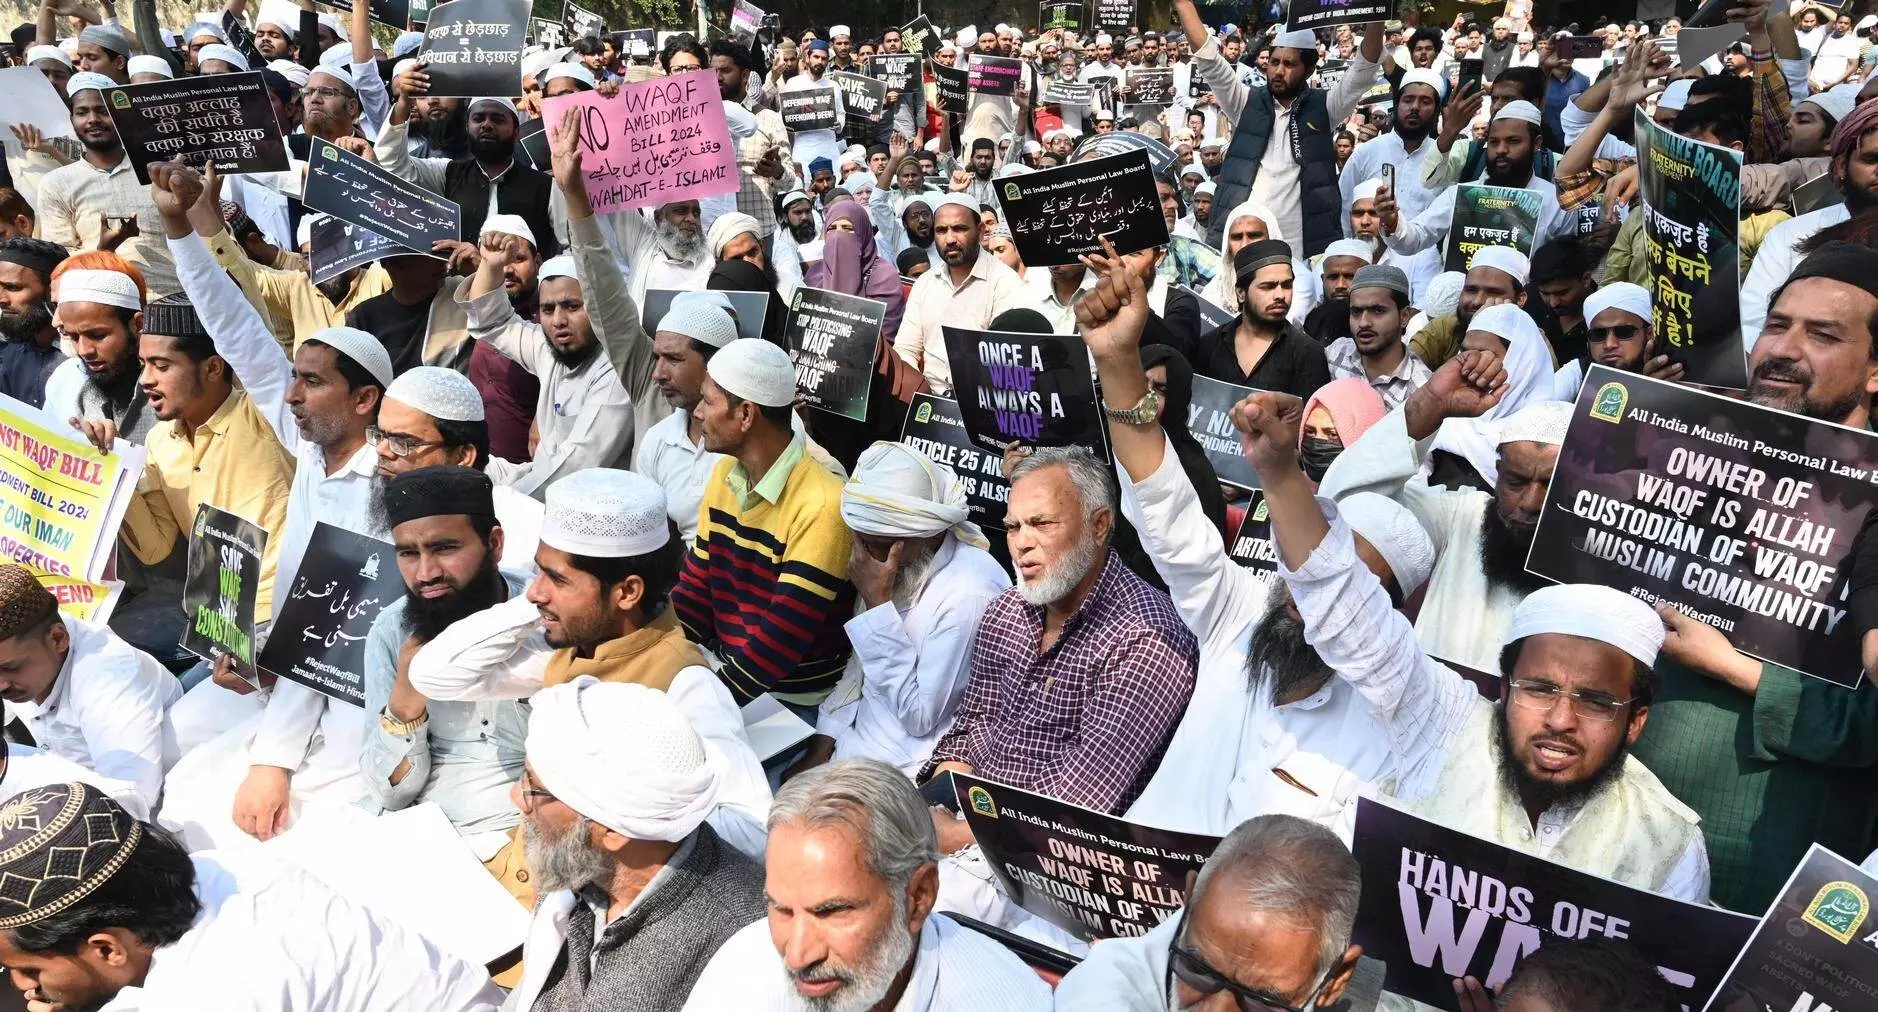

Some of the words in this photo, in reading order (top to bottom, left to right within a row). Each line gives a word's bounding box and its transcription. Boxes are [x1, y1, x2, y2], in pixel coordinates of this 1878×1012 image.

[886, 63, 907, 74] WAQF
[143, 93, 162, 102] India
[164, 91, 190, 100] Muslim
[191, 86, 222, 98] Personal
[239, 83, 259, 91] Board
[626, 80, 697, 113] WAQF
[838, 78, 866, 94] SAVE
[887, 79, 907, 89] WAQF
[849, 93, 878, 113] WAQF
[623, 102, 709, 136] AMENDMENT
[187, 131, 205, 146] के
[631, 133, 666, 152] BILL
[670, 123, 703, 142] 2024
[1650, 148, 1695, 178] FRATERNITY
[1656, 164, 1683, 181] MOVEMENT
[368, 171, 392, 186] Muslim
[1022, 187, 1033, 195] All
[1033, 183, 1050, 193] India
[1051, 181, 1076, 190] Muslim
[1077, 173, 1107, 185] Personal
[1109, 170, 1123, 178] Law
[1124, 164, 1145, 173] Board
[1059, 198, 1073, 211] تحفظ
[1078, 195, 1093, 207] کے
[1114, 207, 1124, 217] اور
[1478, 198, 1516, 207] FRATERNITY
[1032, 218, 1045, 230] تحفظ
[1050, 217, 1064, 227] کے
[1067, 213, 1085, 227] حقوق
[1464, 226, 1477, 237] हम
[1479, 228, 1509, 242] एकजुट
[1654, 210, 1693, 248] एकजुट
[1665, 242, 1712, 286] बेचने
[1658, 275, 1692, 319] लिए
[797, 314, 810, 327] STOP
[814, 305, 829, 313] Muslim
[829, 308, 849, 318] Personal
[850, 312, 861, 320] Law
[861, 315, 878, 324] Board
[801, 327, 836, 359] WAQF
[979, 341, 1022, 368] ONCE
[1031, 346, 1044, 371] A
[988, 364, 1036, 394] WAQF
[977, 385, 1042, 415] ALWAYS
[1051, 392, 1065, 418] A
[940, 416, 956, 426] India
[994, 408, 1044, 442] WAQF
[903, 435, 958, 466] ARTICLE
[958, 449, 980, 471] 25
[1627, 408, 1648, 423] All
[1650, 413, 1688, 433] India
[1691, 424, 1749, 451] Muslim
[1752, 440, 1826, 470] Personal
[1829, 460, 1868, 480] Law
[23, 433, 60, 472] WAQF
[59, 451, 103, 486] BILL
[1668, 447, 1766, 499] OWNER
[1771, 477, 1813, 509] OF
[30, 487, 54, 509] BILL
[3, 504, 32, 535] OUR
[34, 518, 74, 552] IMAN
[1637, 473, 1707, 520] WAQF
[1710, 496, 1741, 528] IS
[1744, 508, 1836, 556] ALLAH
[1573, 489, 1704, 555] CUSTODIAN
[1710, 534, 1747, 566] OF
[1754, 546, 1836, 596] WAQF
[221, 544, 243, 576] SAVE
[219, 565, 241, 605] WAQF
[1583, 527, 1676, 582] MUSLIM
[1682, 562, 1847, 636] COMMUNITY
[292, 665, 346, 692] Jamaat-e-Islami
[305, 656, 360, 684] #RejectWaqfBill
[1001, 807, 1016, 818] All
[1018, 811, 1049, 828] India
[1052, 821, 1097, 842] Muslim
[1099, 834, 1158, 857] Personal
[1162, 847, 1192, 862] Law
[1036, 854, 1094, 891] WAQF
[1101, 874, 1124, 896] IS
[1048, 837, 1127, 876] OWNER
[1133, 860, 1161, 883] OF
[1004, 862, 1111, 914] CUSTODIAN
[1117, 900, 1144, 921] OF
[1401, 846, 1535, 924] HANDS
[1551, 900, 1631, 941] OFF
